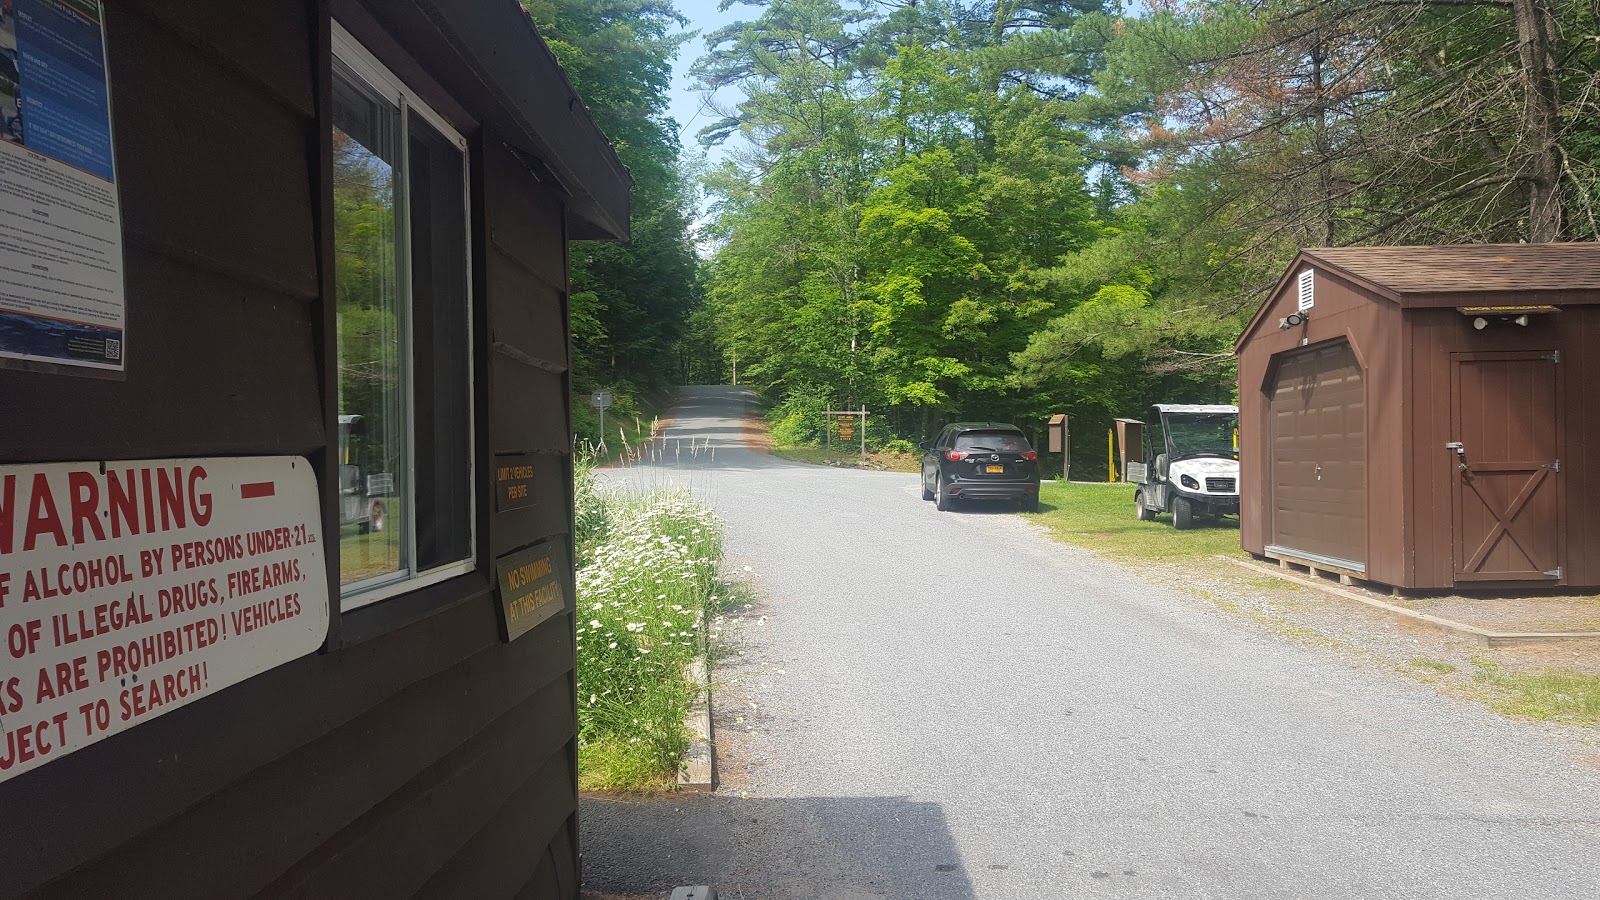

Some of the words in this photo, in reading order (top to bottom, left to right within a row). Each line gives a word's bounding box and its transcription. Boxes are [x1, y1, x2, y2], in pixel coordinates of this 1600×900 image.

[498, 467, 509, 481] LIMIT
[513, 466, 533, 480] VEHICLES
[508, 486, 517, 499] PER
[518, 485, 527, 498] SITE
[22, 554, 133, 603] ALCOHOL
[140, 548, 164, 578] BY
[171, 534, 244, 572] PERSONS
[508, 571, 520, 591] NO
[520, 557, 551, 585] SWIMMING
[8, 620, 42, 659] OF
[52, 594, 153, 647] ILLEGAL
[159, 578, 225, 618] DRUGS,
[227, 558, 306, 599] FIREARMS,
[510, 601, 519, 622] AT
[519, 595, 535, 617] THIS
[535, 581, 559, 608] FACILITY
[36, 662, 90, 704] ARE
[96, 613, 227, 683] PROHIBITED!
[232, 592, 301, 636] VEHICLES
[0, 712, 68, 770] JECT
[80, 699, 110, 737] TO
[119, 661, 209, 721] SEARCH!
